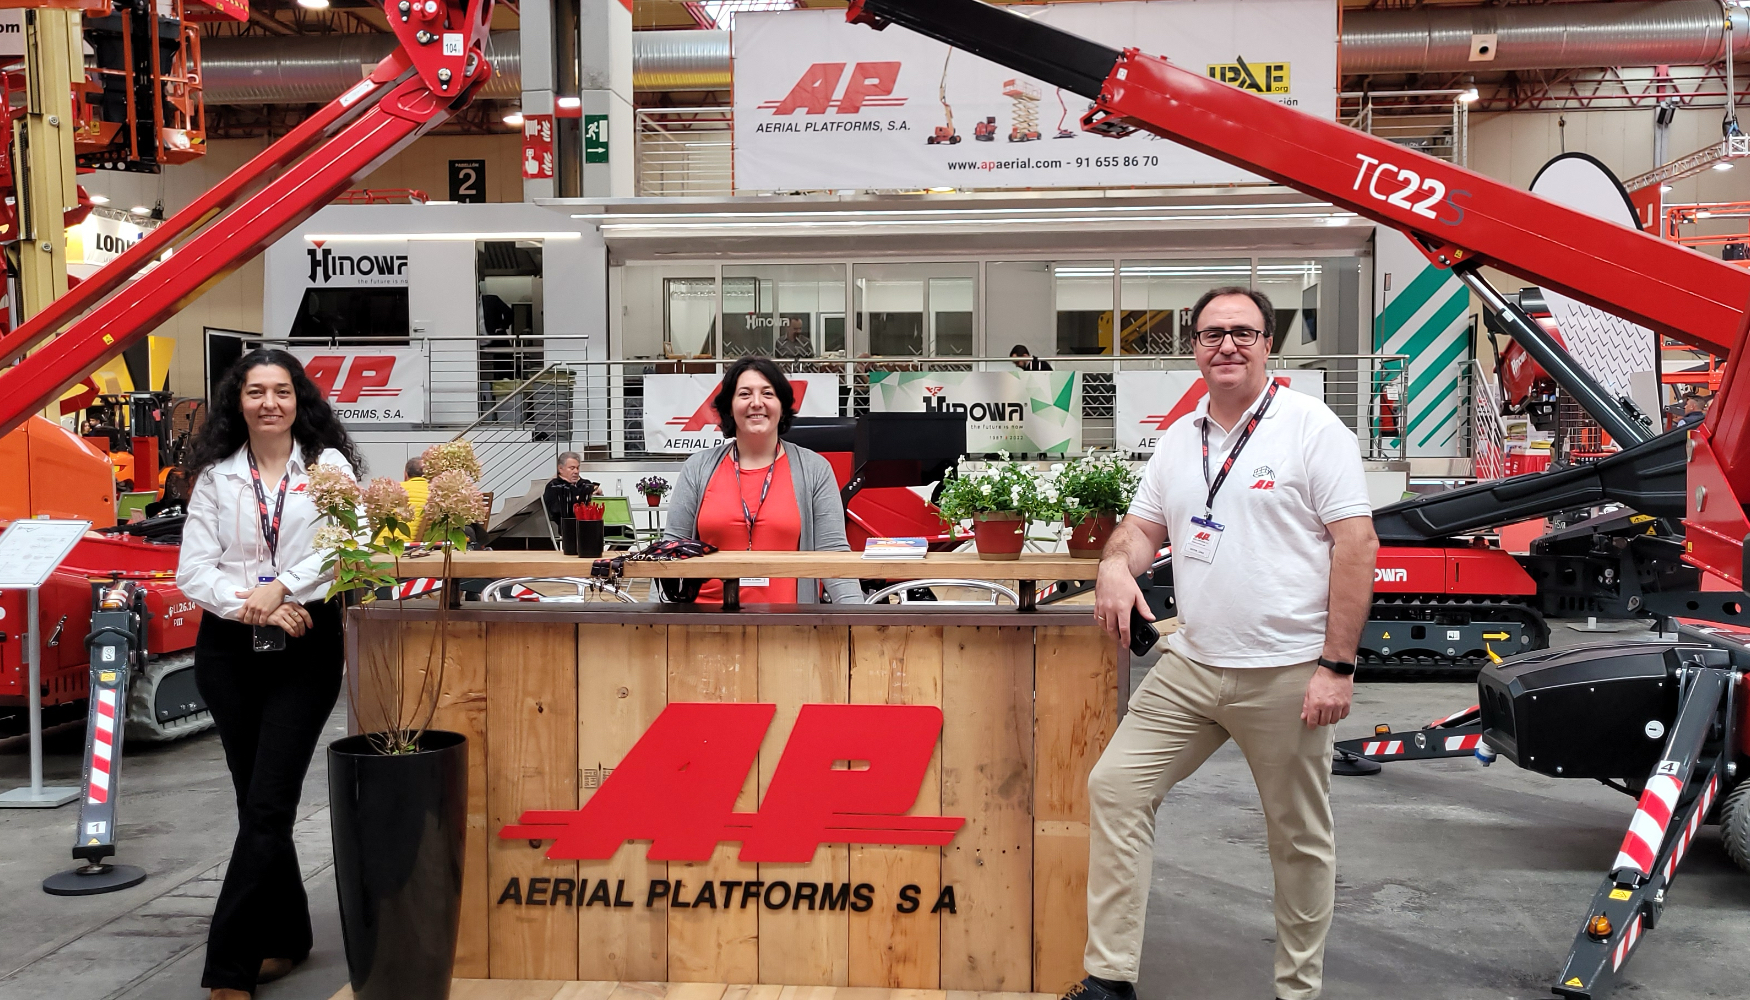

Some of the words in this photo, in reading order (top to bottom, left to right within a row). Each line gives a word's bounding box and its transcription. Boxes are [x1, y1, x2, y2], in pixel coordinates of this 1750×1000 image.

[758, 61, 907, 115] AP
[756, 122, 801, 133] AERIAL
[804, 120, 883, 133] PLATFORMS,
[887, 120, 911, 132] S.A.
[947, 157, 1062, 172] www.apaerial.com
[1075, 157, 1091, 168] 91
[1095, 156, 1119, 168] 655
[1123, 156, 1139, 167] 86
[1142, 155, 1159, 167] 70
[458, 168, 477, 195] 2
[1352, 152, 1473, 226] TC22S
[382, 409, 404, 419] S.A.
[663, 438, 710, 449] AERIAL
[1248, 479, 1276, 490] AP
[1194, 531, 1211, 541] AP
[1660, 762, 1675, 773] 4
[499, 702, 966, 864] AP
[92, 822, 100, 833] 1
[499, 876, 634, 908] AERIAL
[645, 879, 876, 913] PLATFORMS
[896, 885, 921, 915] S
[930, 885, 958, 915] A
